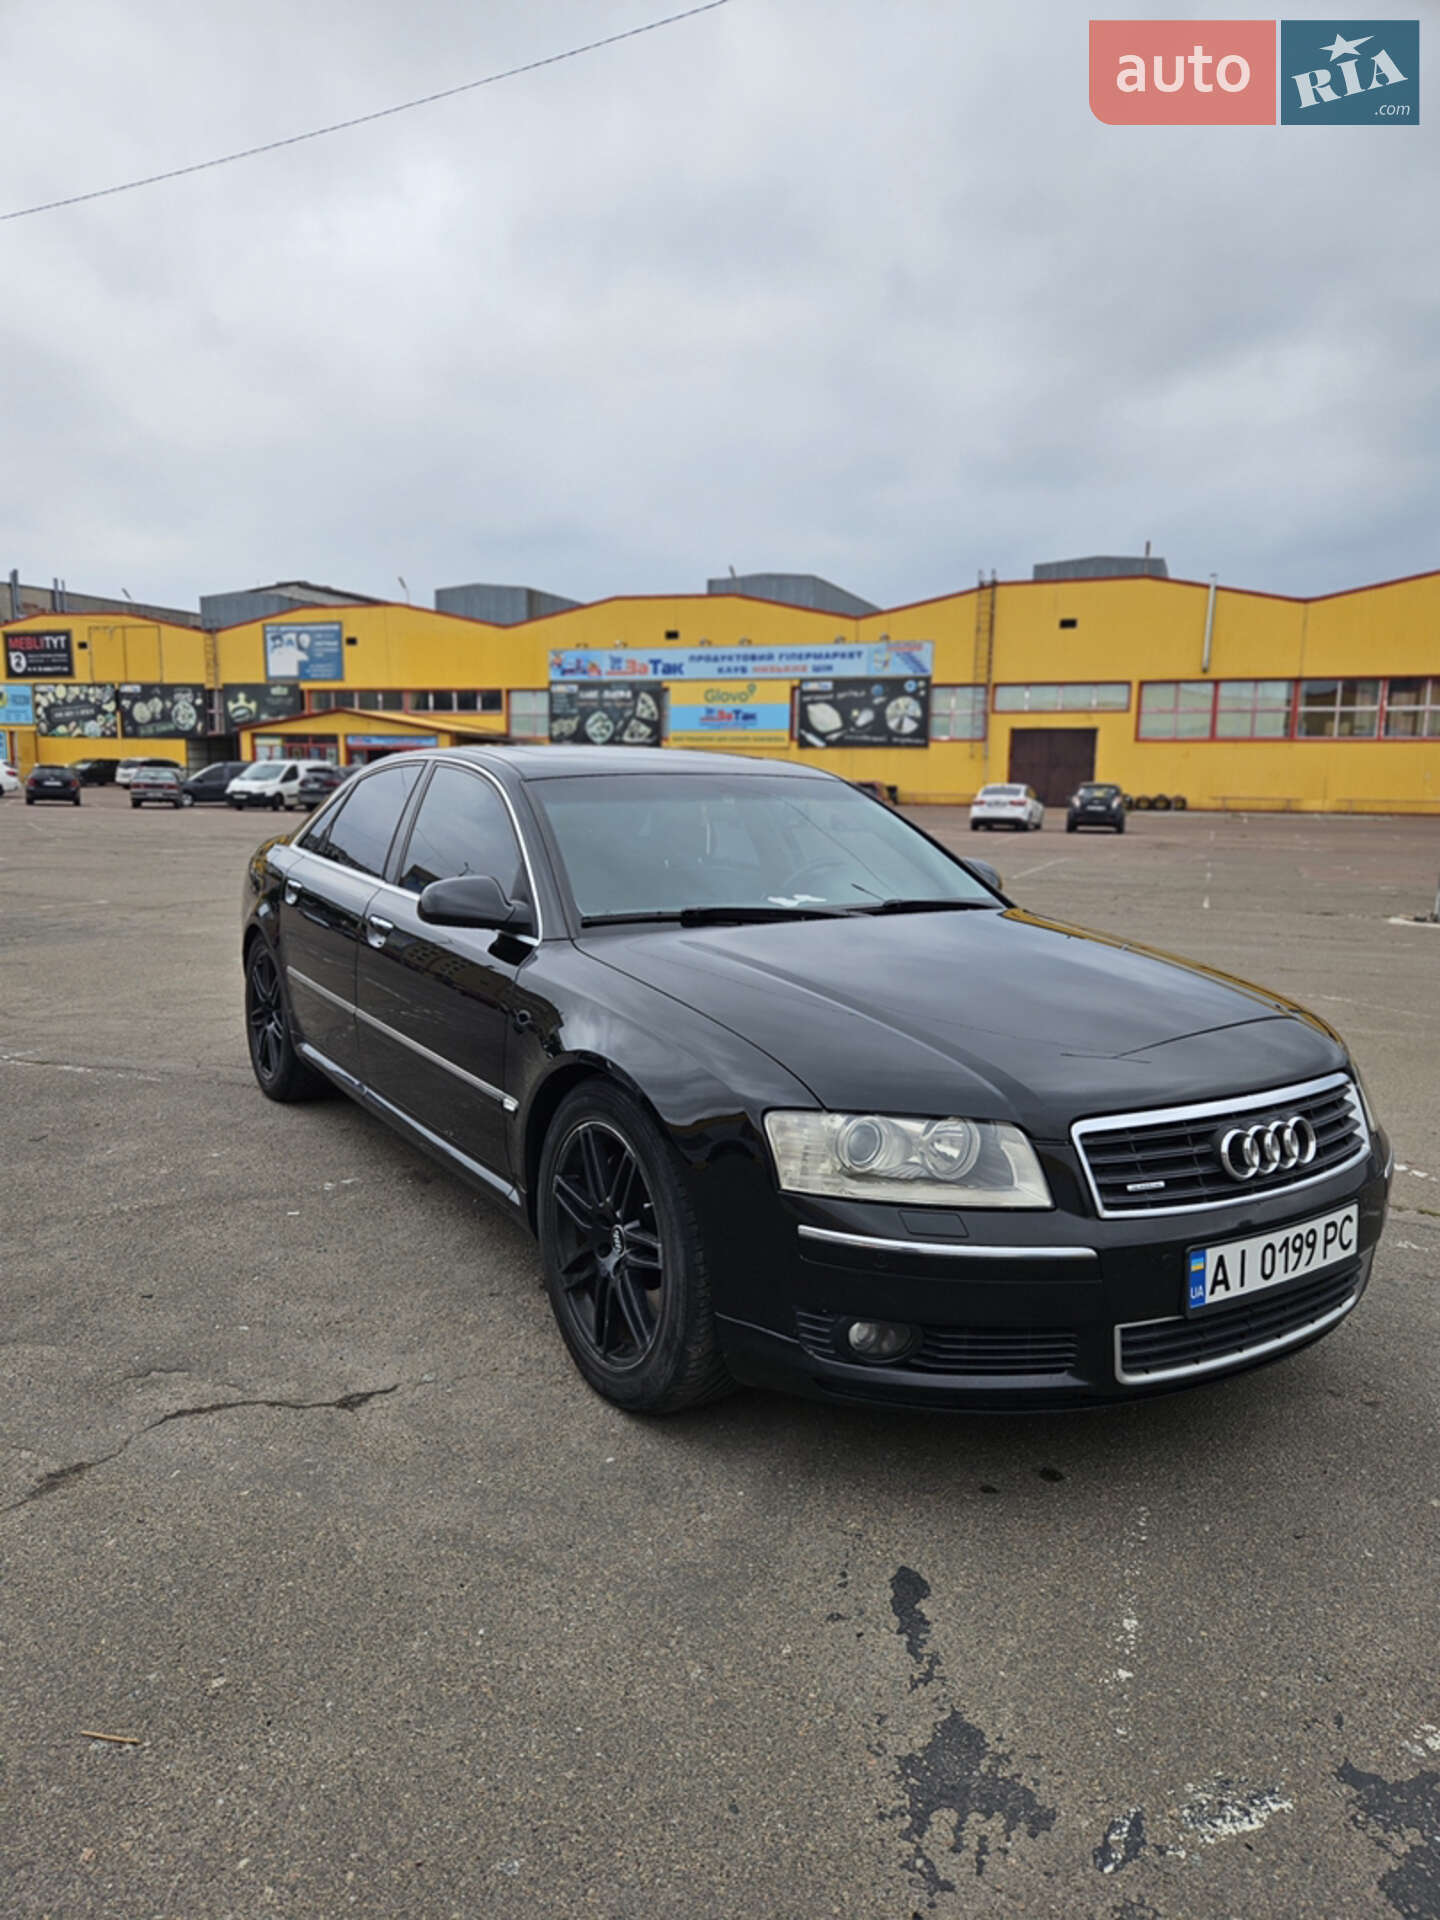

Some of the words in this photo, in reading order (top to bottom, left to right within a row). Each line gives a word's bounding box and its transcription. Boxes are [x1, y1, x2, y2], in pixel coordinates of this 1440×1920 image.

[704, 688, 750, 704] Glovo
[1209, 1249, 1246, 1296] AI
[1260, 1228, 1317, 1281] 0199
[1322, 1214, 1354, 1260] PC
[1190, 1285, 1205, 1299] UA
